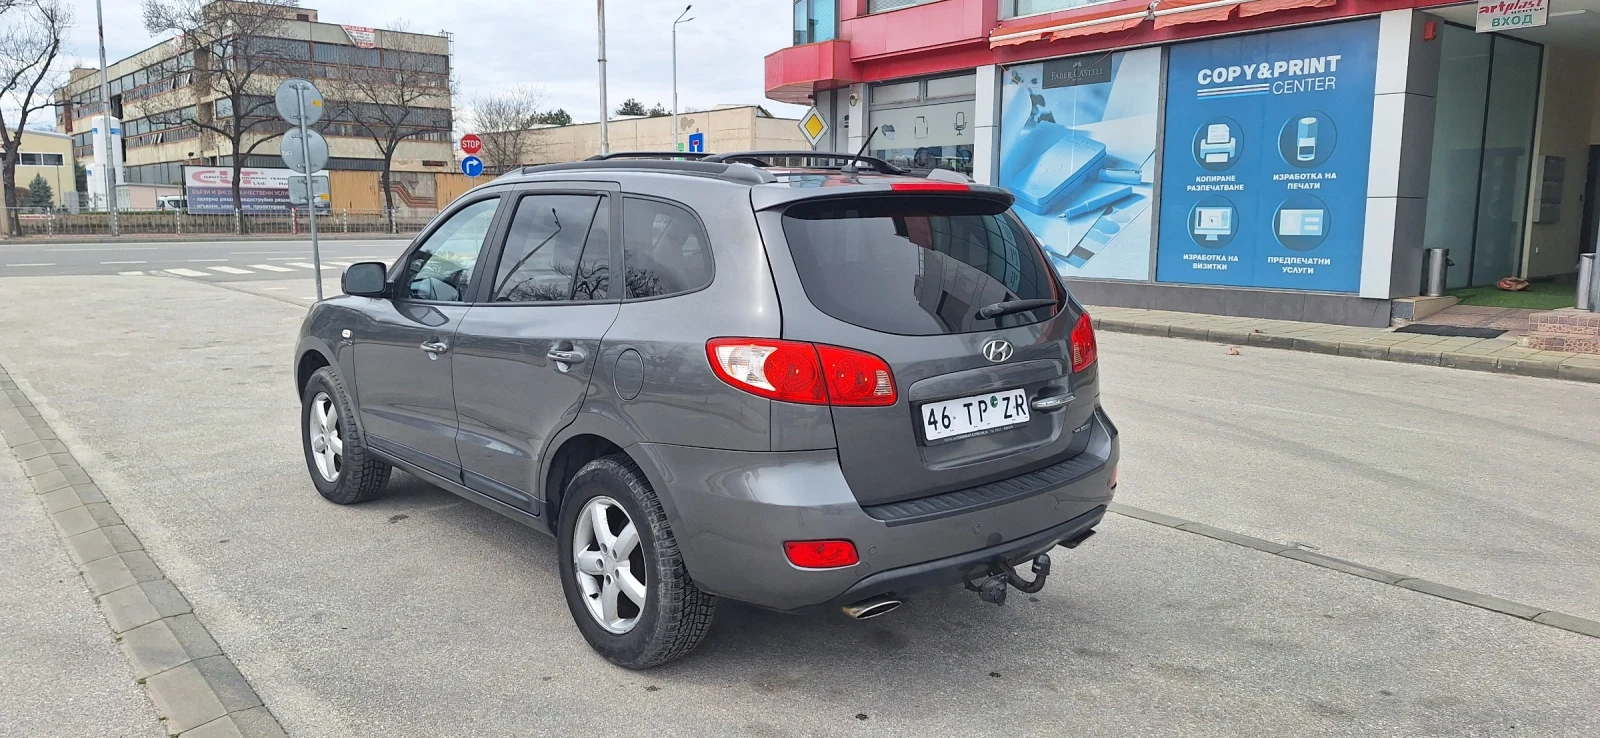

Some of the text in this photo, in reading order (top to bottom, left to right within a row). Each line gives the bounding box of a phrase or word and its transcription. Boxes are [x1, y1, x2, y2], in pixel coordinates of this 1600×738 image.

[1491, 14, 1532, 27] ВХОД
[1051, 68, 1104, 80] FABER-CASTELL
[1197, 55, 1341, 85] COPY&PRINT
[1272, 76, 1336, 95] CENTER
[462, 140, 480, 148] STOP
[1273, 172, 1337, 181] ИЗРАБОТКА НА
[1186, 184, 1245, 192] РАЗПЕЧАТВАНЕ
[1287, 182, 1321, 190] ПЕЧАТИ
[1183, 254, 1226, 262] ИЗРАБОТКА
[1267, 256, 1331, 266] ПРЕДПЕЧАТНИ
[1192, 263, 1228, 271] ВИЗИТКИ
[1282, 266, 1315, 275] УСЛУГИ
[928, 394, 1027, 431] 46 TP ZR
